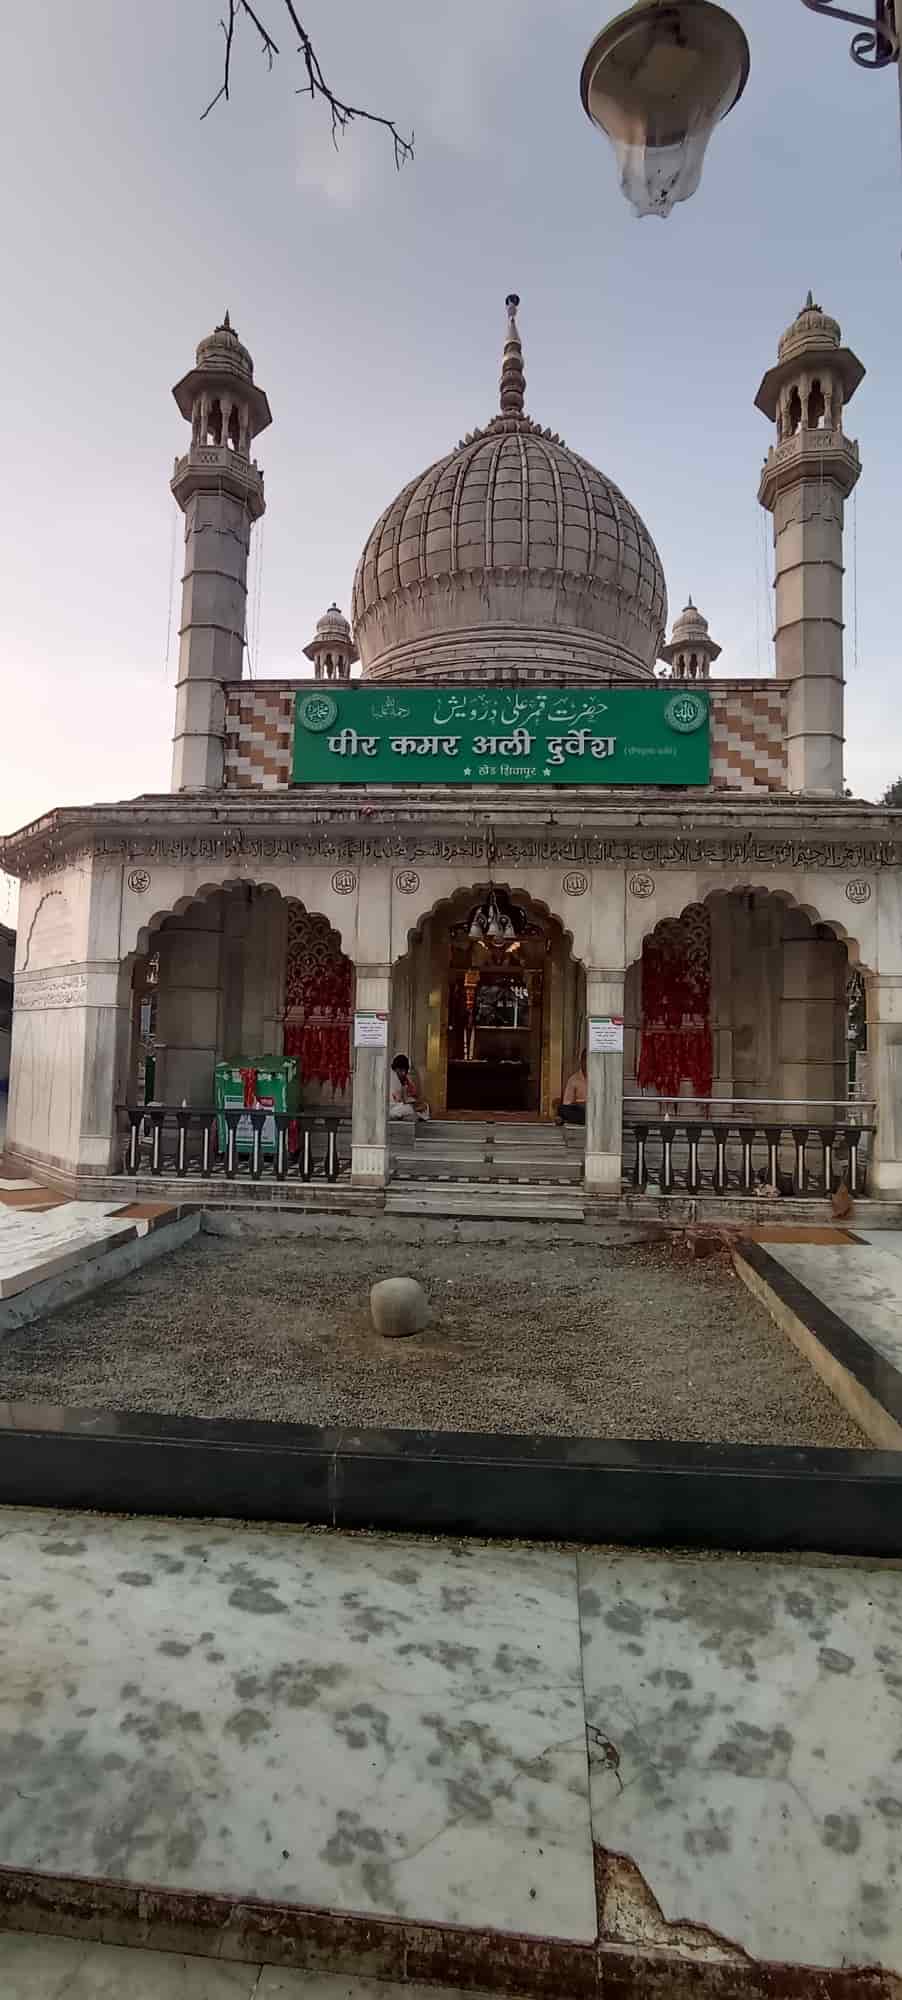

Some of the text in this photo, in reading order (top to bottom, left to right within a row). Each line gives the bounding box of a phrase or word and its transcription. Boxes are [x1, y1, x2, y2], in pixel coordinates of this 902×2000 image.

[327, 728, 380, 756] पीर
[389, 736, 462, 756] कमर
[472, 728, 536, 756] अली
[545, 728, 616, 765] दुर्वेश
